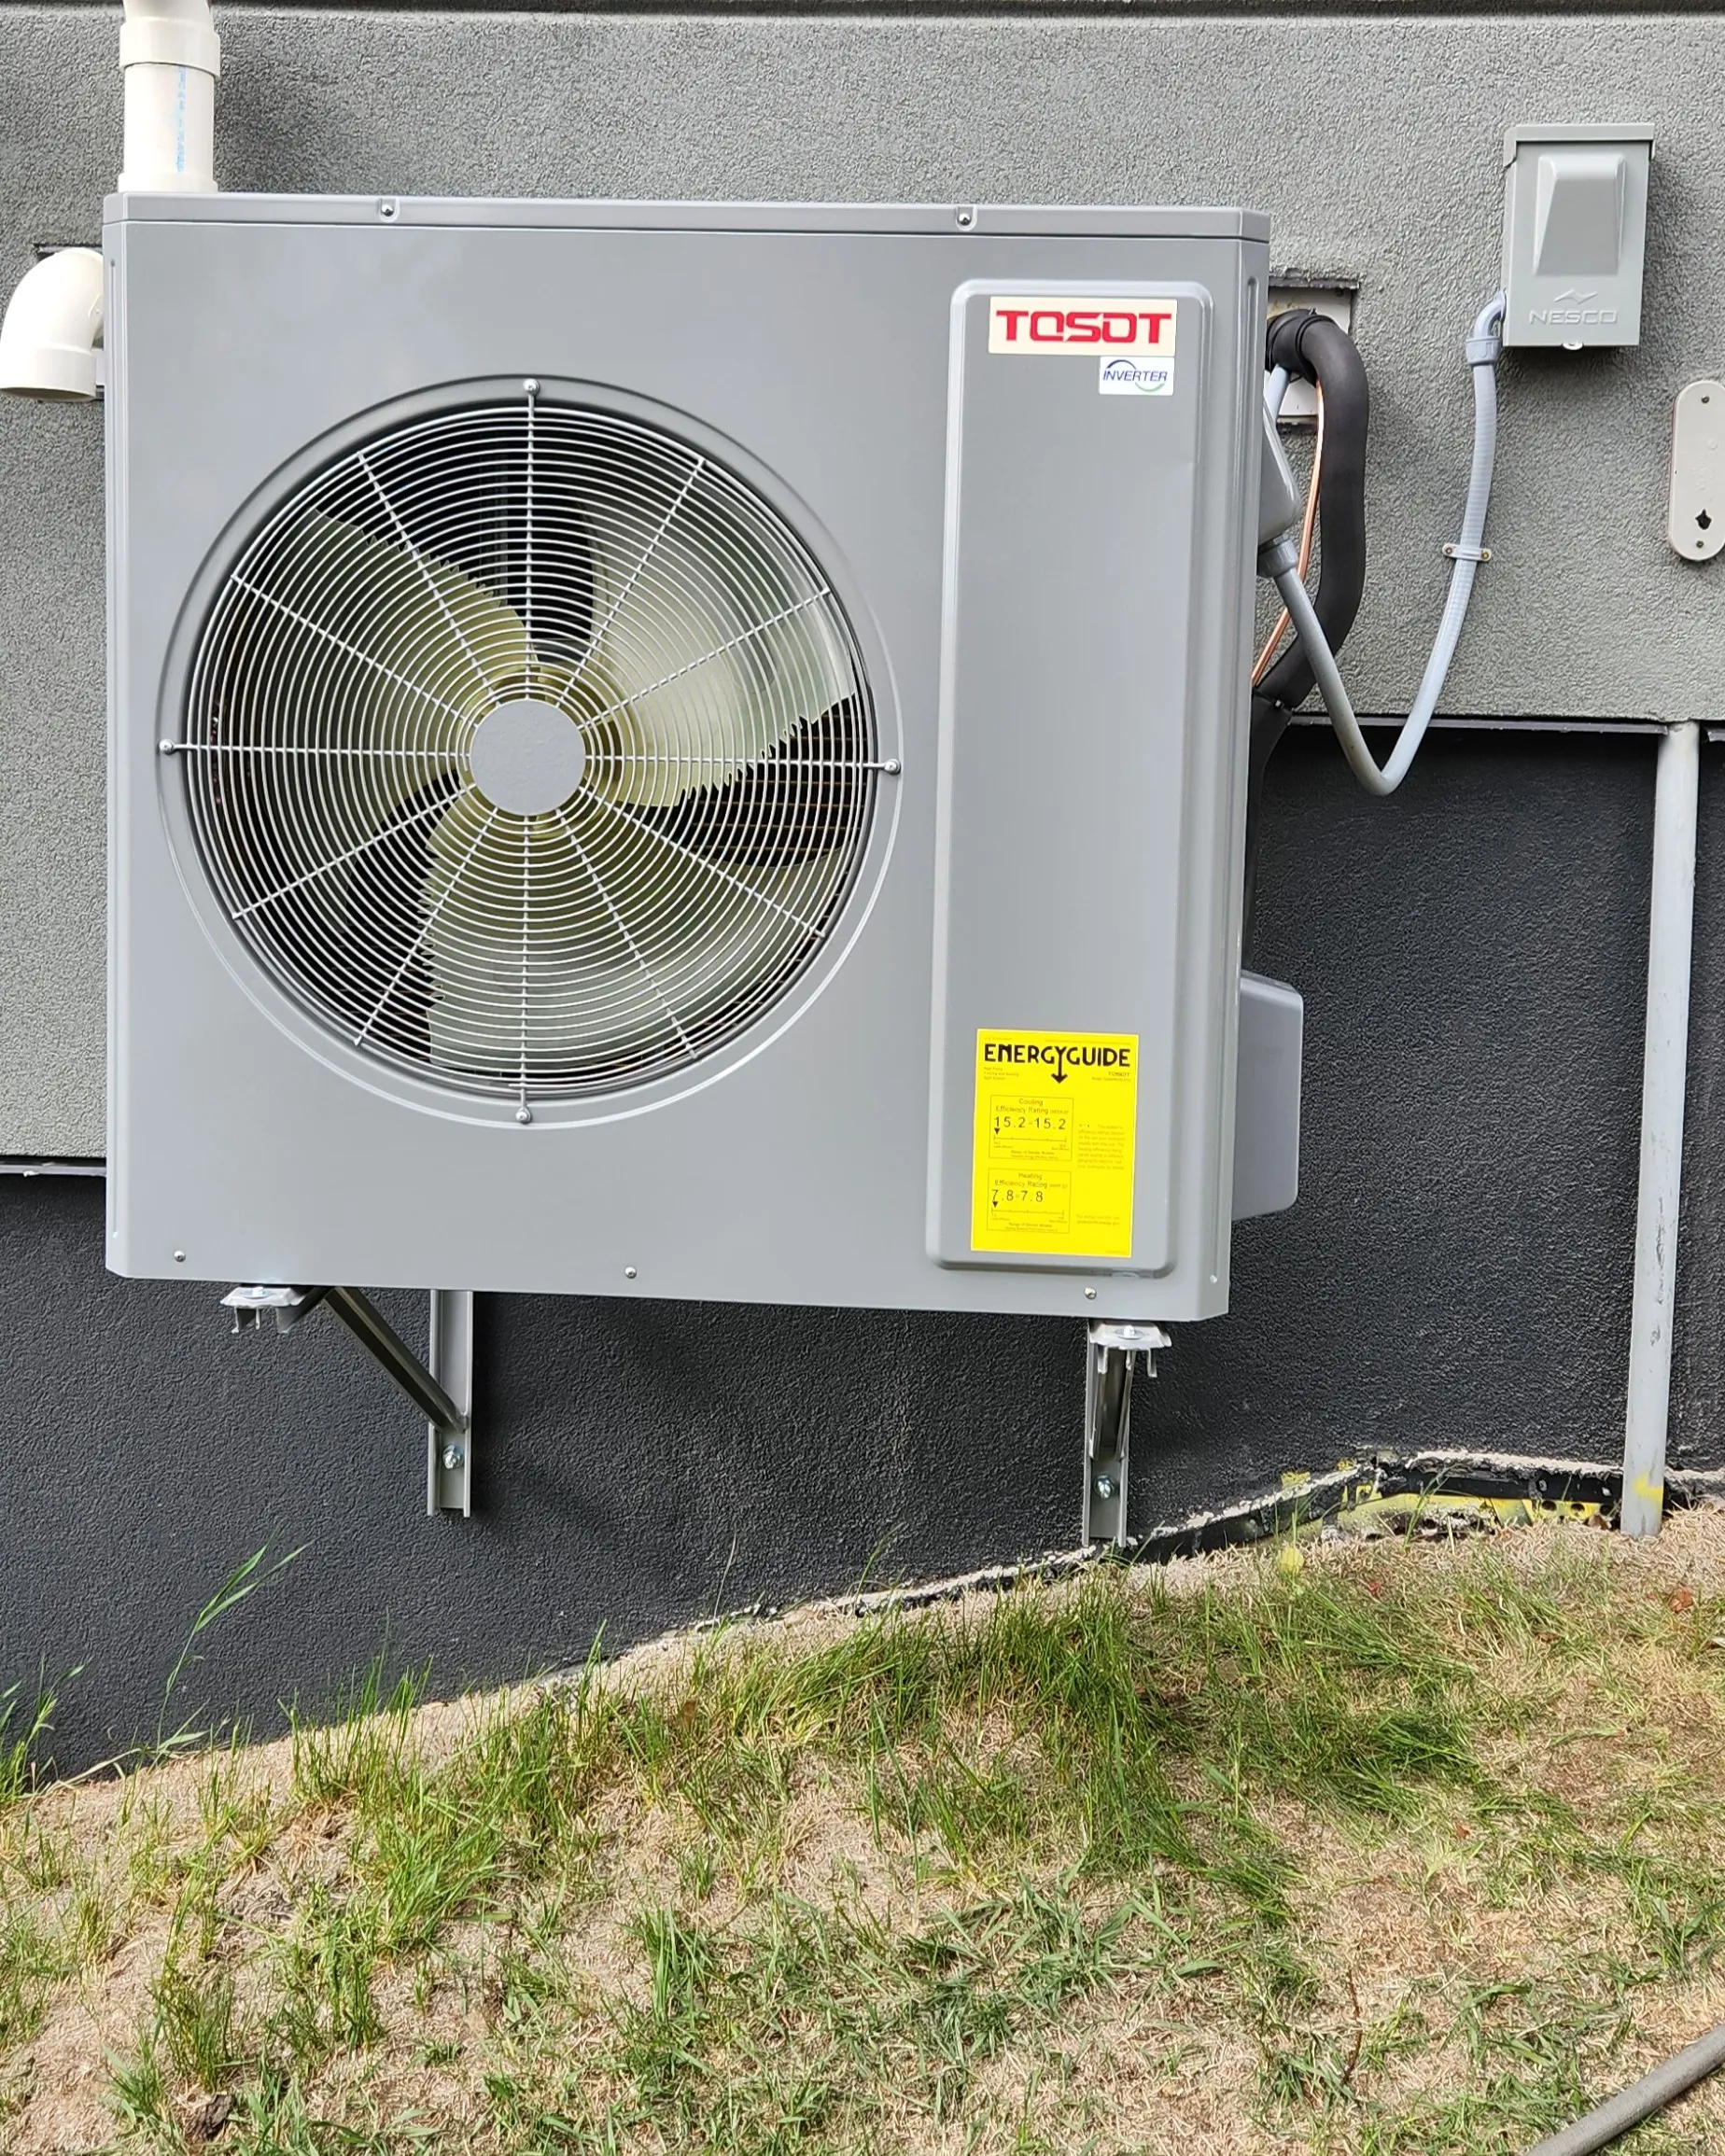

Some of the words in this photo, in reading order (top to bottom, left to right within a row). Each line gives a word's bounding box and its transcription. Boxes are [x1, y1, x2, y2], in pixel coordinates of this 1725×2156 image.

[1529, 309, 1618, 325] NESCO
[996, 310, 1171, 343] TOSOT
[1102, 370, 1168, 382] INVERTER
[984, 1043, 1130, 1069] ENERGYGUIDE
[1018, 1099, 1044, 1107] Cooling
[995, 1105, 1027, 1114] Efficiency
[1018, 1172, 1043, 1181] Heating
